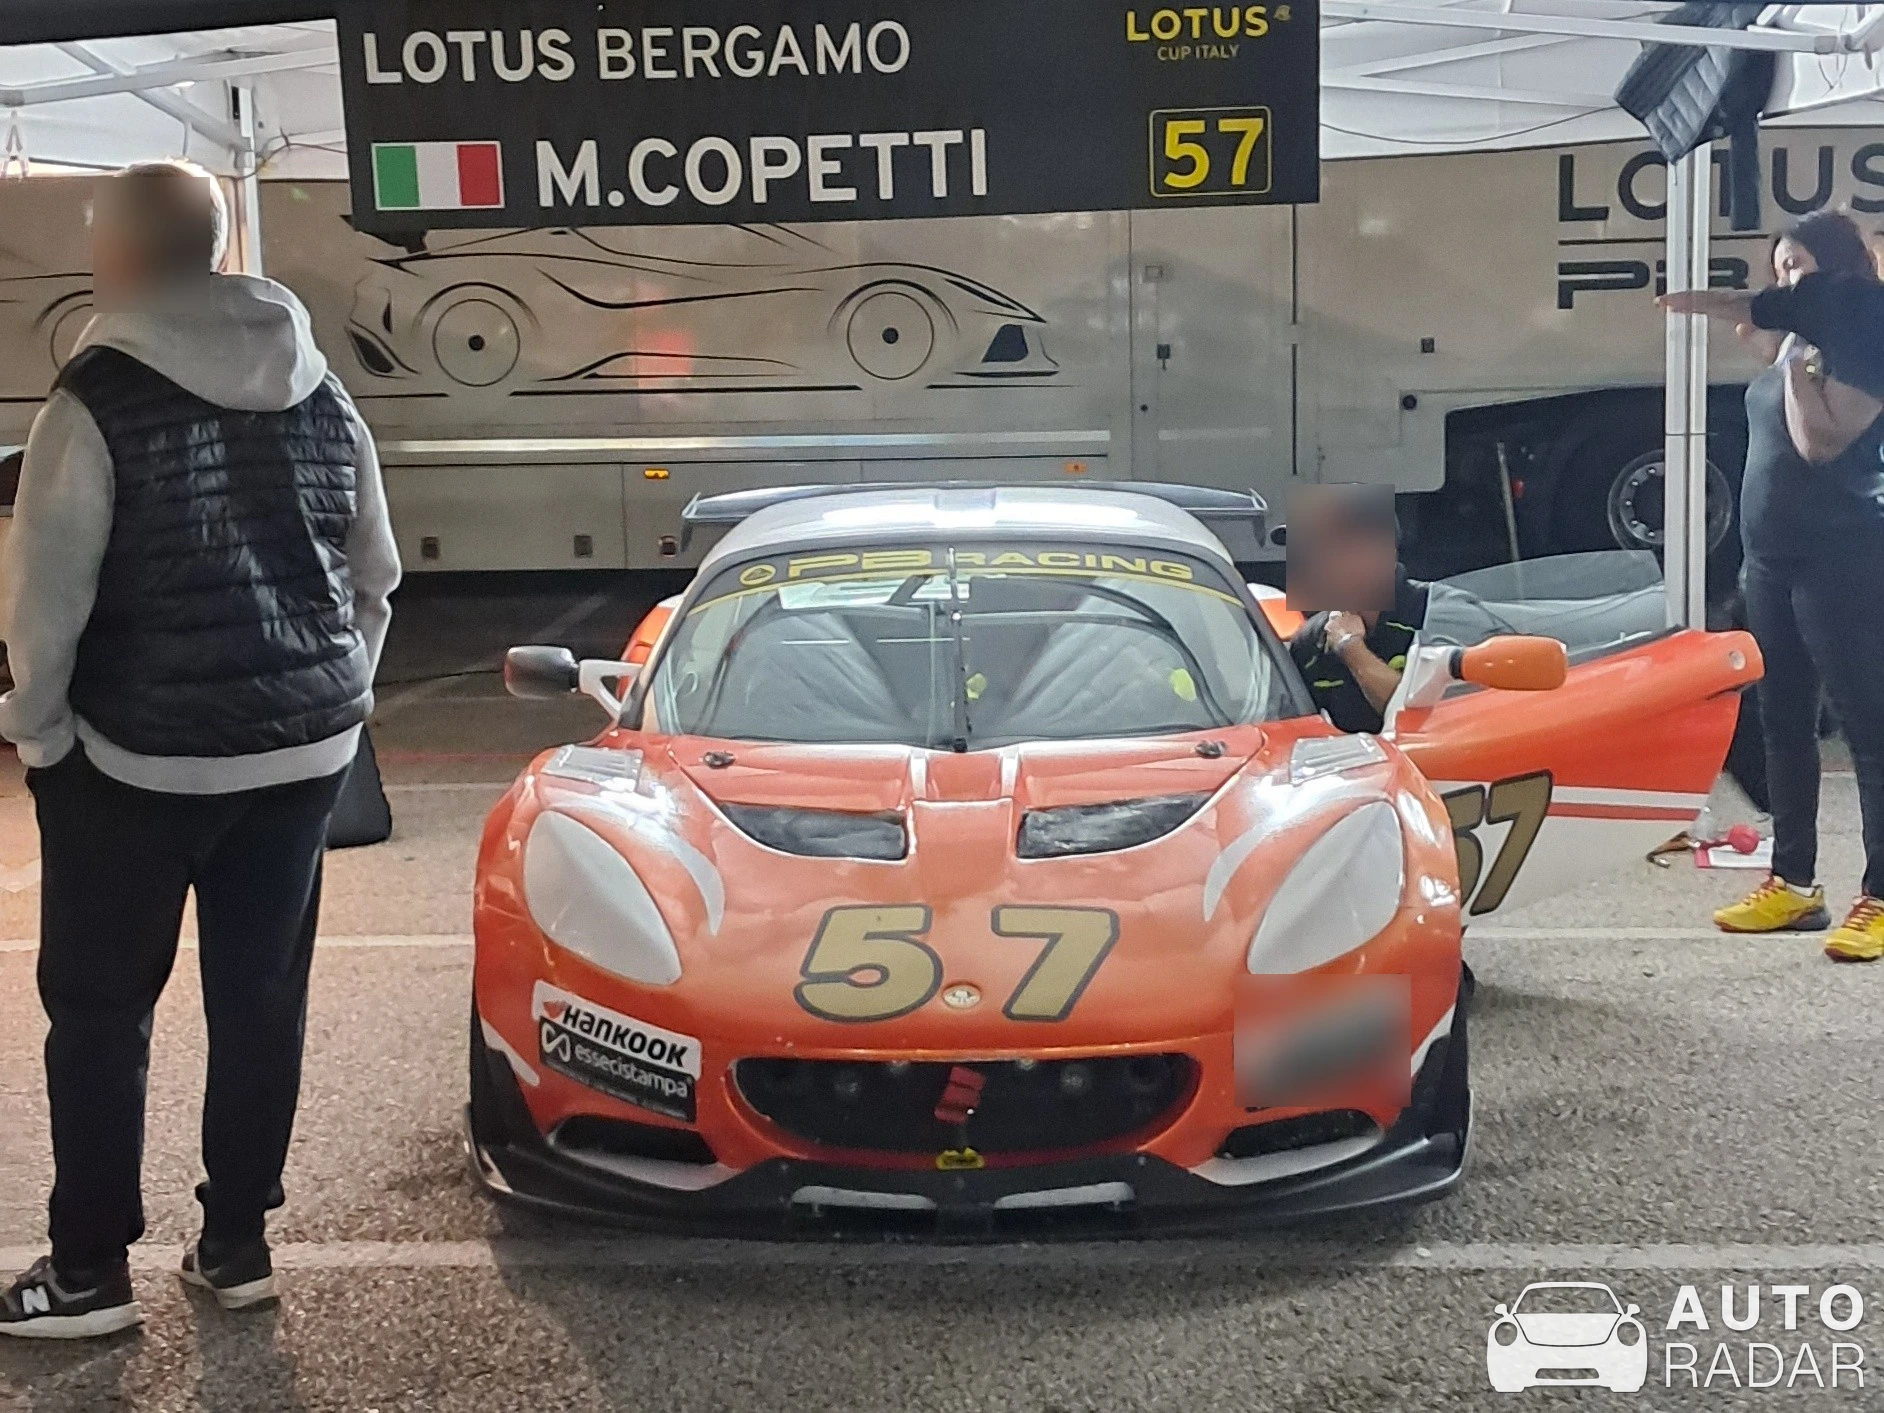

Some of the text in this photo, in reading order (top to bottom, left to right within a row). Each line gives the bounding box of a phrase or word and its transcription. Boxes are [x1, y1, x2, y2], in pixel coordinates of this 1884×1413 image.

[1126, 6, 1269, 41] LOTUS
[363, 20, 911, 84] LOTUS BERGAMO
[1157, 44, 1240, 61] CUP ITALY
[536, 128, 988, 208] M.COPETTI
[1163, 117, 1264, 188] 57
[788, 550, 1194, 580] PB RACING
[574, 1044, 688, 1098] essecistampa
[22, 1285, 50, 1315] N
